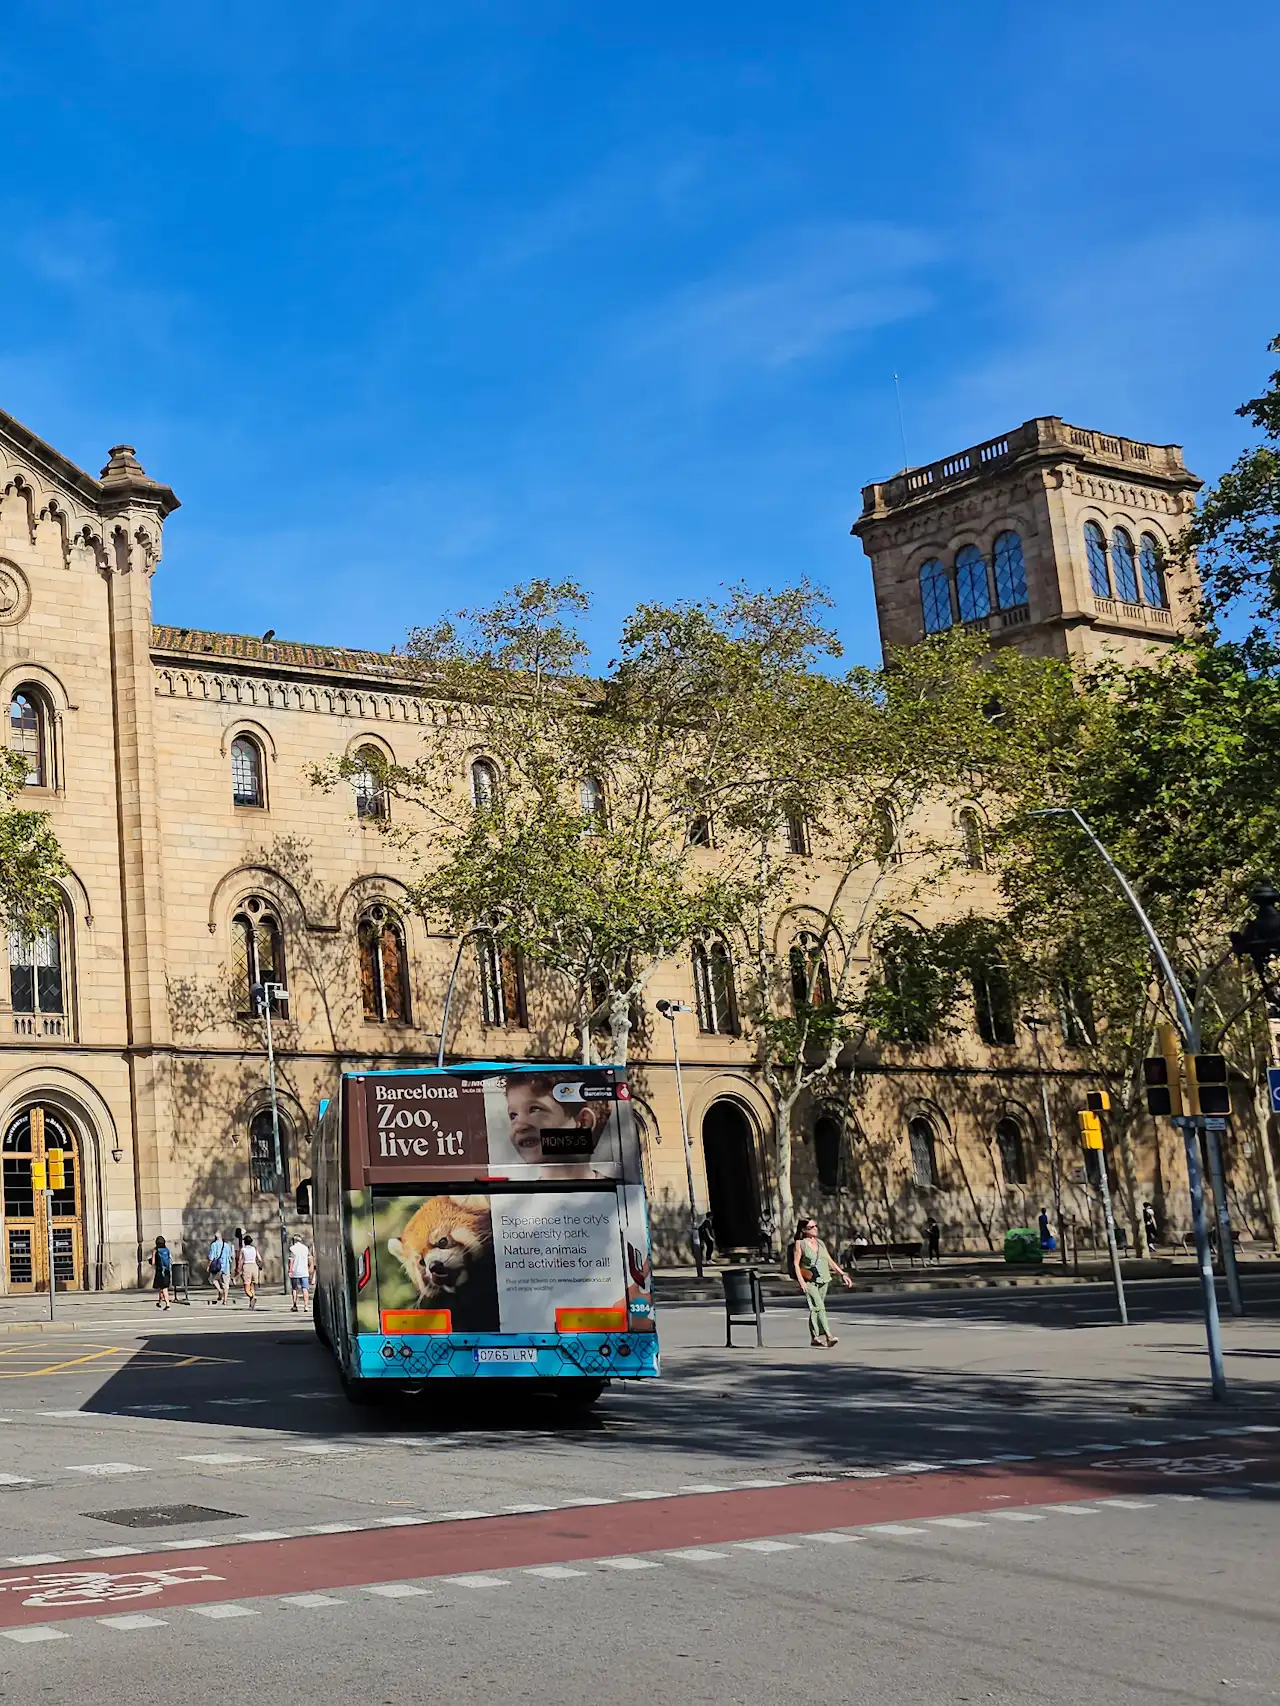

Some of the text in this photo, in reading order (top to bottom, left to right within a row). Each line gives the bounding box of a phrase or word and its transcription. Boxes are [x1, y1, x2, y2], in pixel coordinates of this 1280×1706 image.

[375, 1083, 459, 1100] Barcelona
[377, 1103, 439, 1132] Zoo,
[379, 1130, 464, 1157] live it!
[501, 1213, 610, 1227] Experience the city's
[502, 1228, 590, 1240] biodiversity park.
[504, 1244, 587, 1256] Nature, animals
[504, 1257, 611, 1269] and activities for all!
[629, 1304, 651, 1313] 3384
[480, 1349, 535, 1361] 0765 LRV
